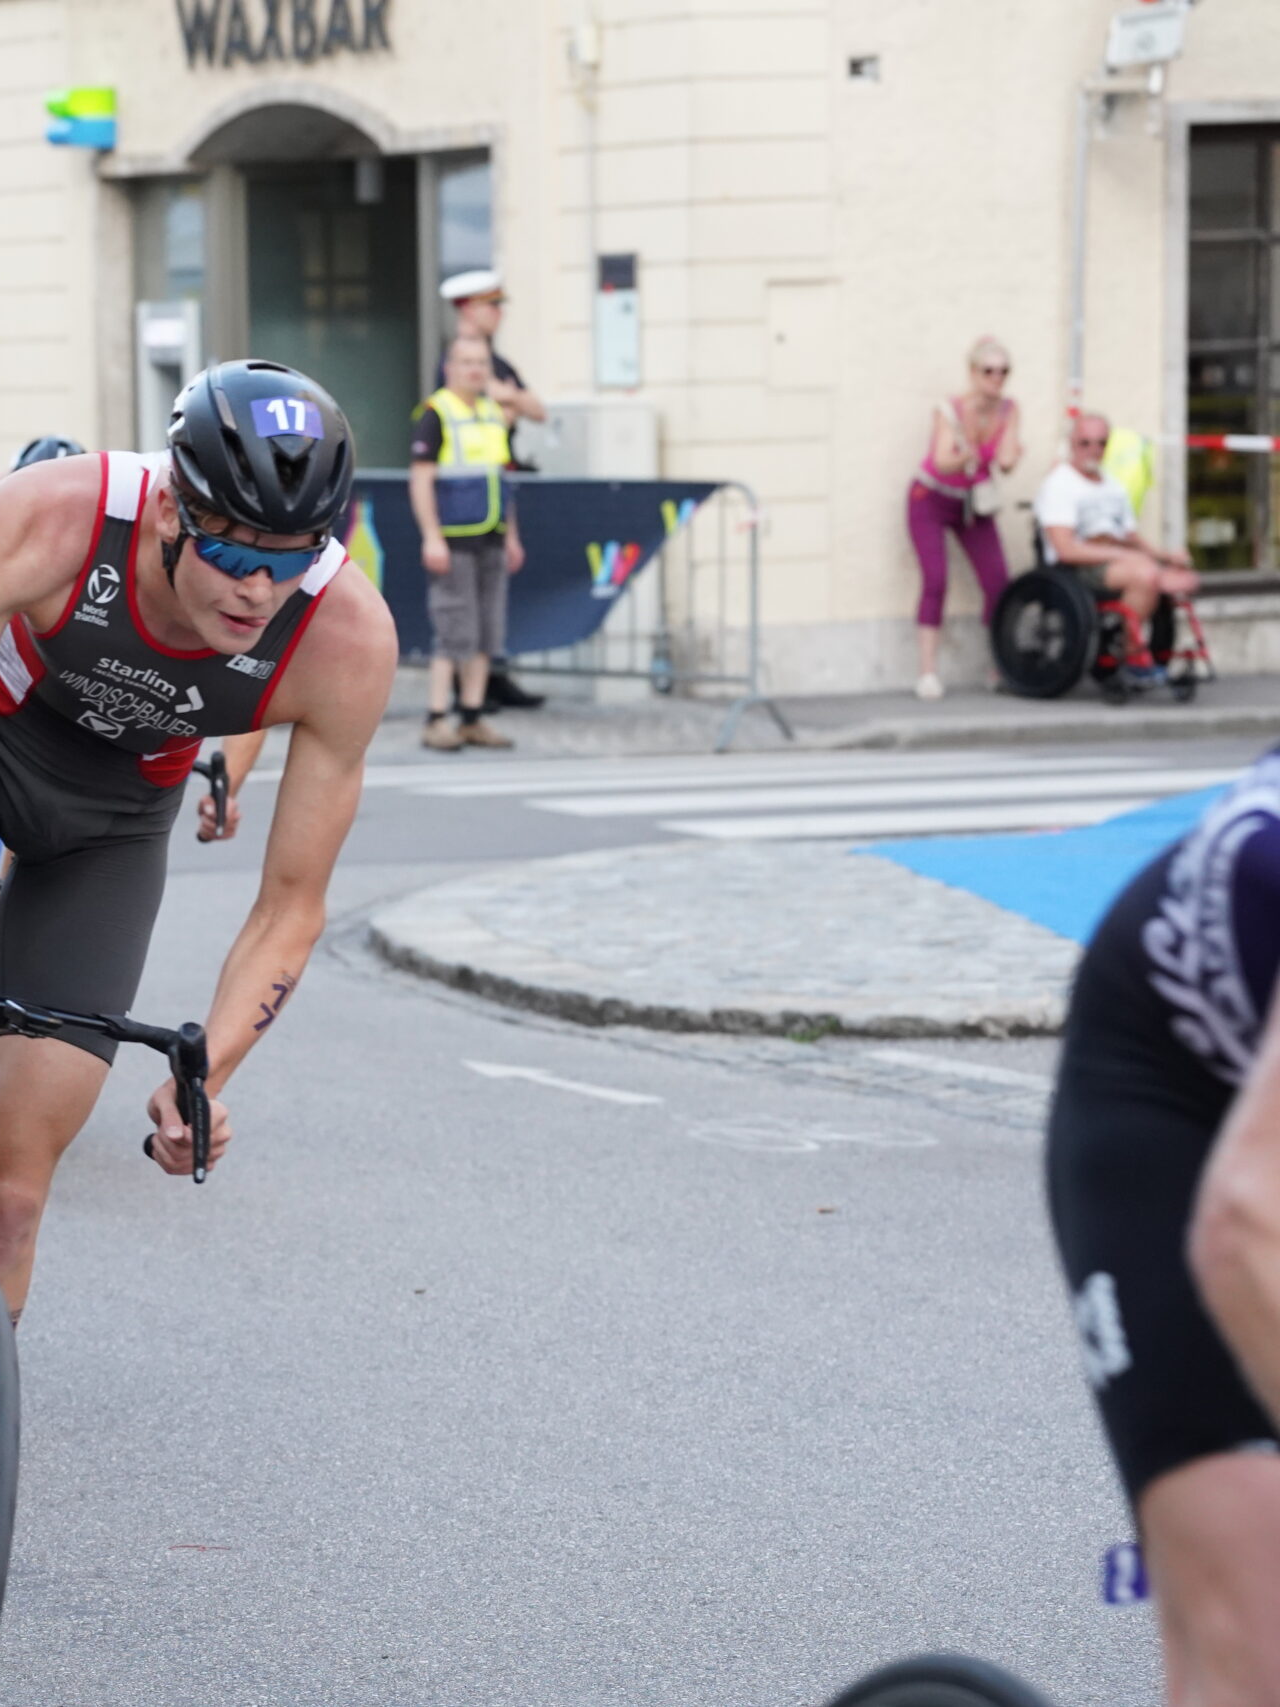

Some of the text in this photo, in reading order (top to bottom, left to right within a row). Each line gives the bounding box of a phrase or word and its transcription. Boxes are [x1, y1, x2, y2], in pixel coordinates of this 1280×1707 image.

[266, 398, 306, 432] 17
[74, 611, 109, 628] Triathlon
[82, 603, 108, 617] World
[97, 657, 177, 697] starlim
[58, 670, 198, 737] WINDISCHBAUER
